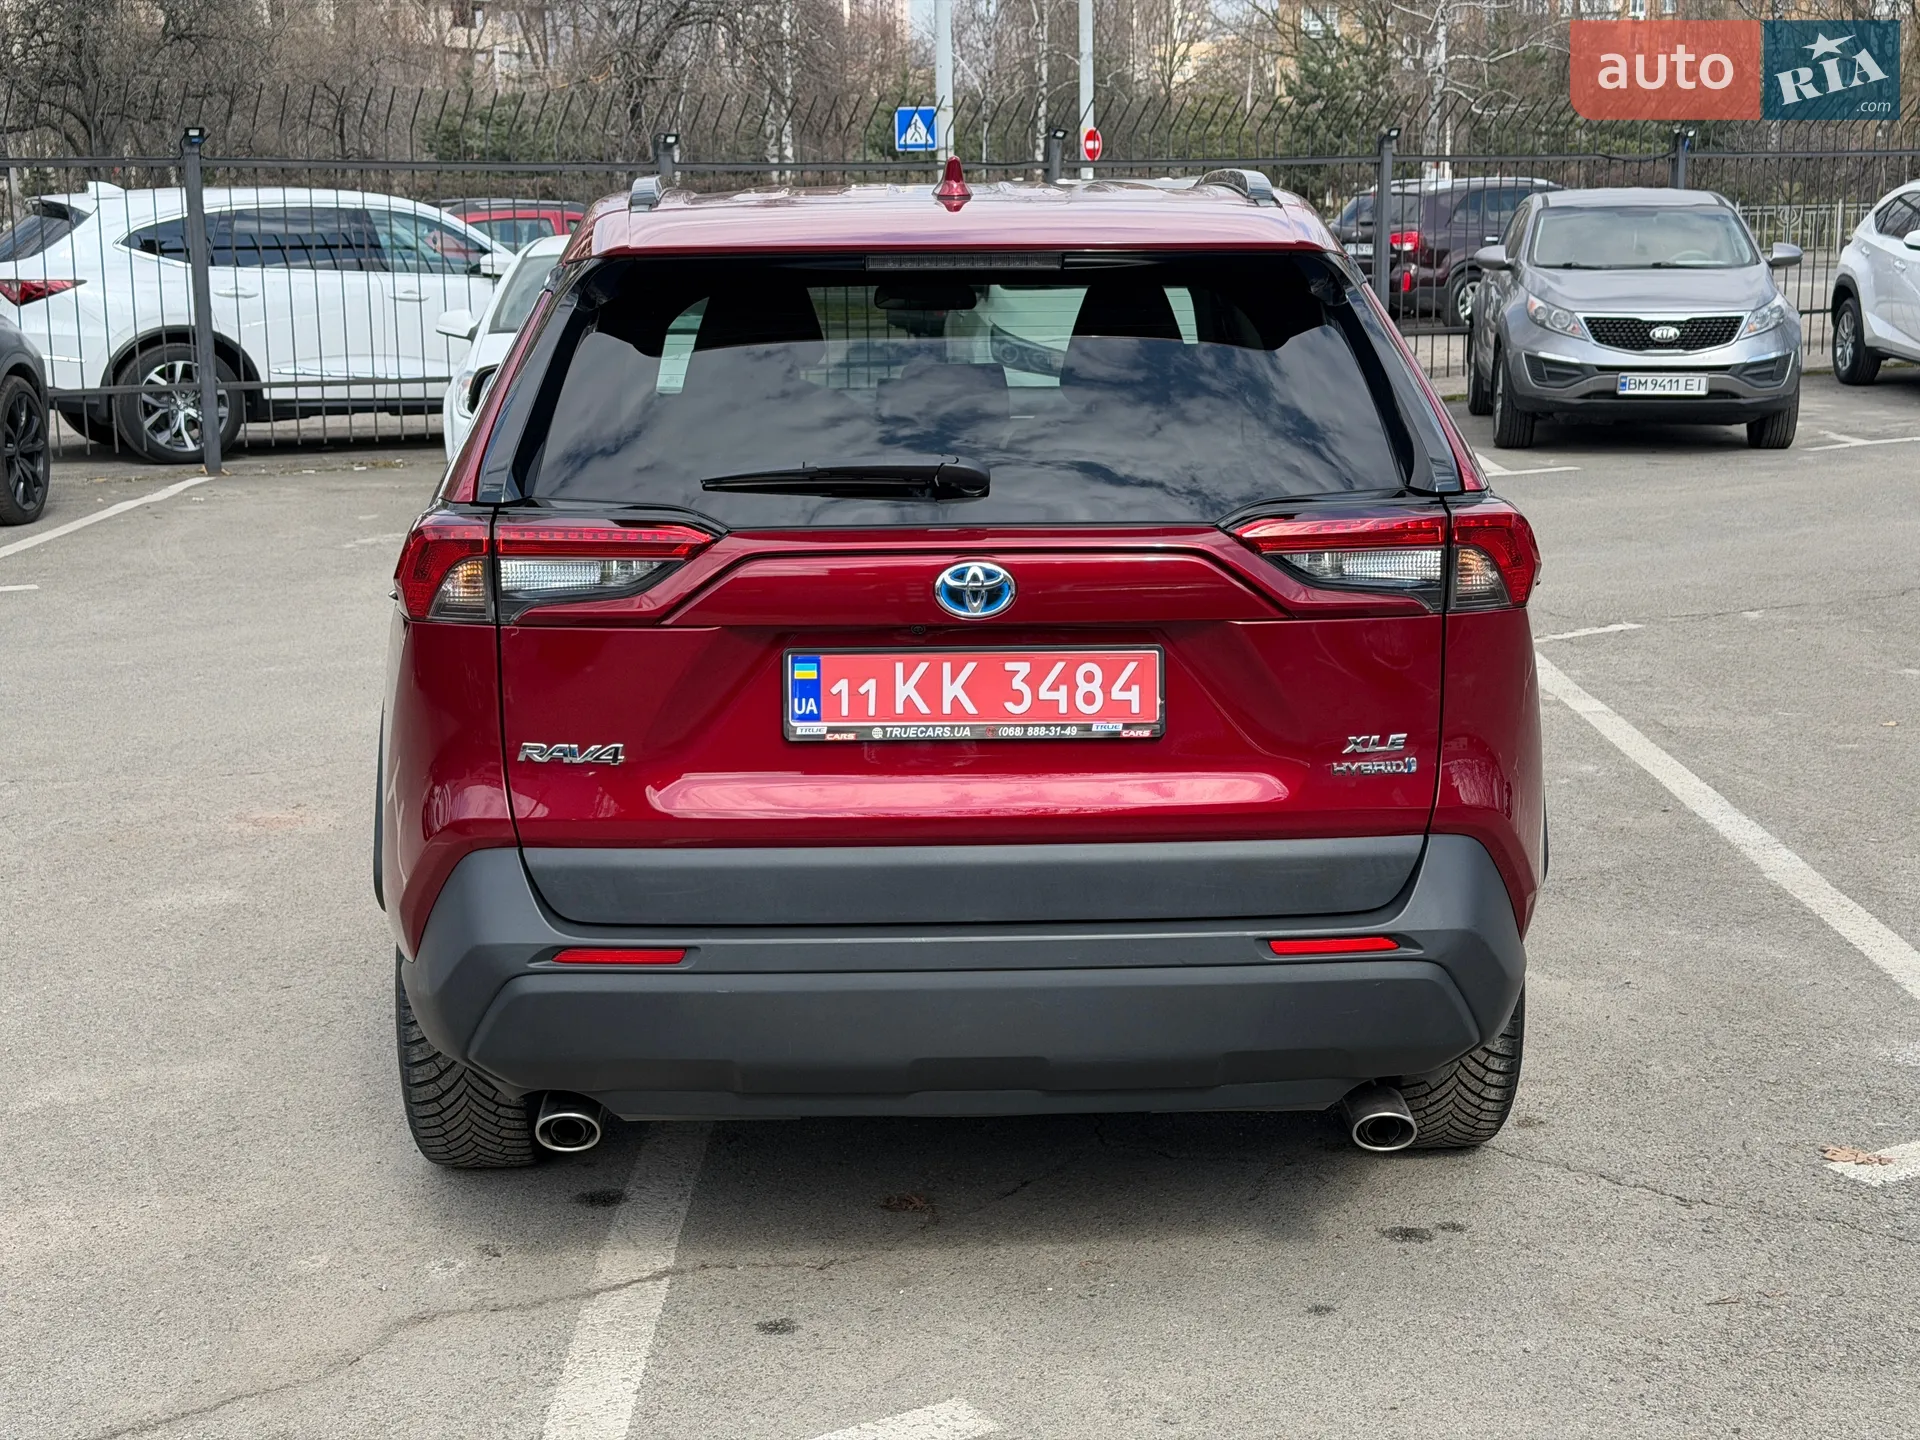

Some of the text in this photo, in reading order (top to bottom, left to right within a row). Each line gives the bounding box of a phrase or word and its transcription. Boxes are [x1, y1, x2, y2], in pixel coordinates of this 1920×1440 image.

[1627, 378, 1648, 391] BM
[1650, 378, 1680, 391] 9411
[829, 661, 1141, 717] 11 KK 3484
[793, 698, 818, 714] UA
[825, 733, 856, 741] CARS
[885, 726, 971, 738] TRUECARS.UA
[998, 726, 1078, 737] (068) 888-31-49
[1121, 730, 1151, 738] CARS
[1341, 733, 1408, 753] XLE
[517, 742, 625, 765] RAV4
[1331, 760, 1405, 775] HYBRID
